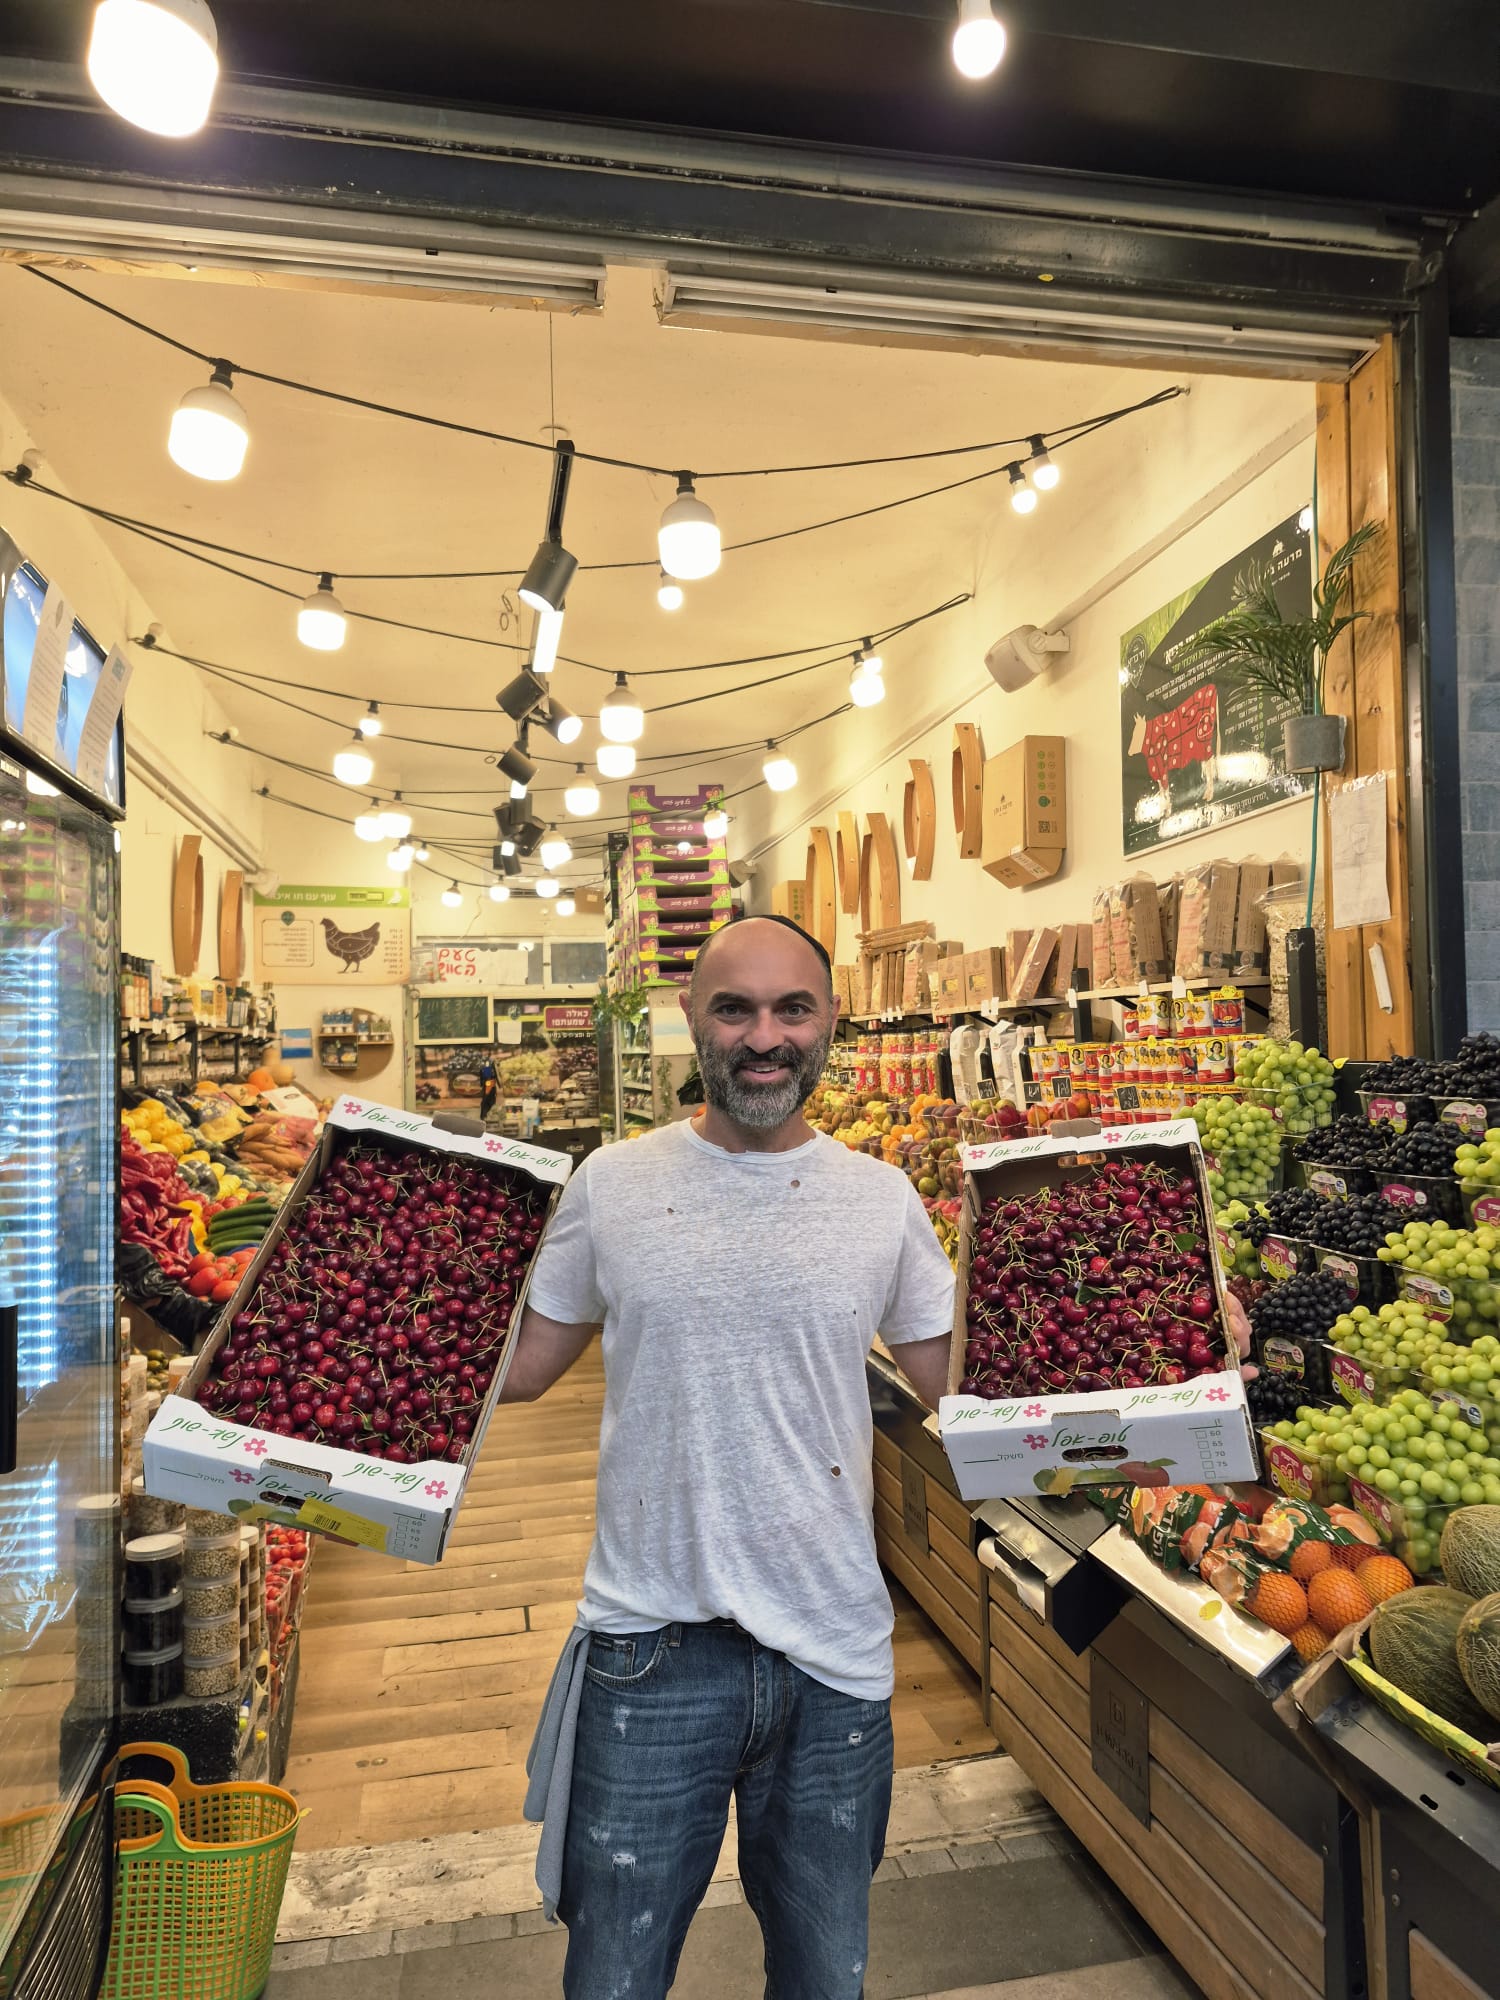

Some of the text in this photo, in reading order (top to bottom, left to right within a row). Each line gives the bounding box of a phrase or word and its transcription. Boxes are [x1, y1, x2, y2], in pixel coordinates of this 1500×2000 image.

[305, 893, 319, 901] עם
[320, 893, 336, 902] עוף
[438, 949, 476, 962] טעם
[566, 1010, 589, 1018] כאלה
[361, 1107, 427, 1132] טופ-אפל
[1124, 1123, 1185, 1143] טופ-אפל
[503, 1144, 565, 1168] טופ-אפל
[988, 1139, 1048, 1159] טופ-אפל
[1124, 1389, 1202, 1411] טופ-אפל
[947, 1405, 1022, 1426] טופ-אפל
[159, 1417, 245, 1449] טופ-אפל
[1050, 1424, 1133, 1447] טופ-אפל
[998, 1451, 1024, 1461] משקל
[342, 1463, 427, 1493] טופ-אפל
